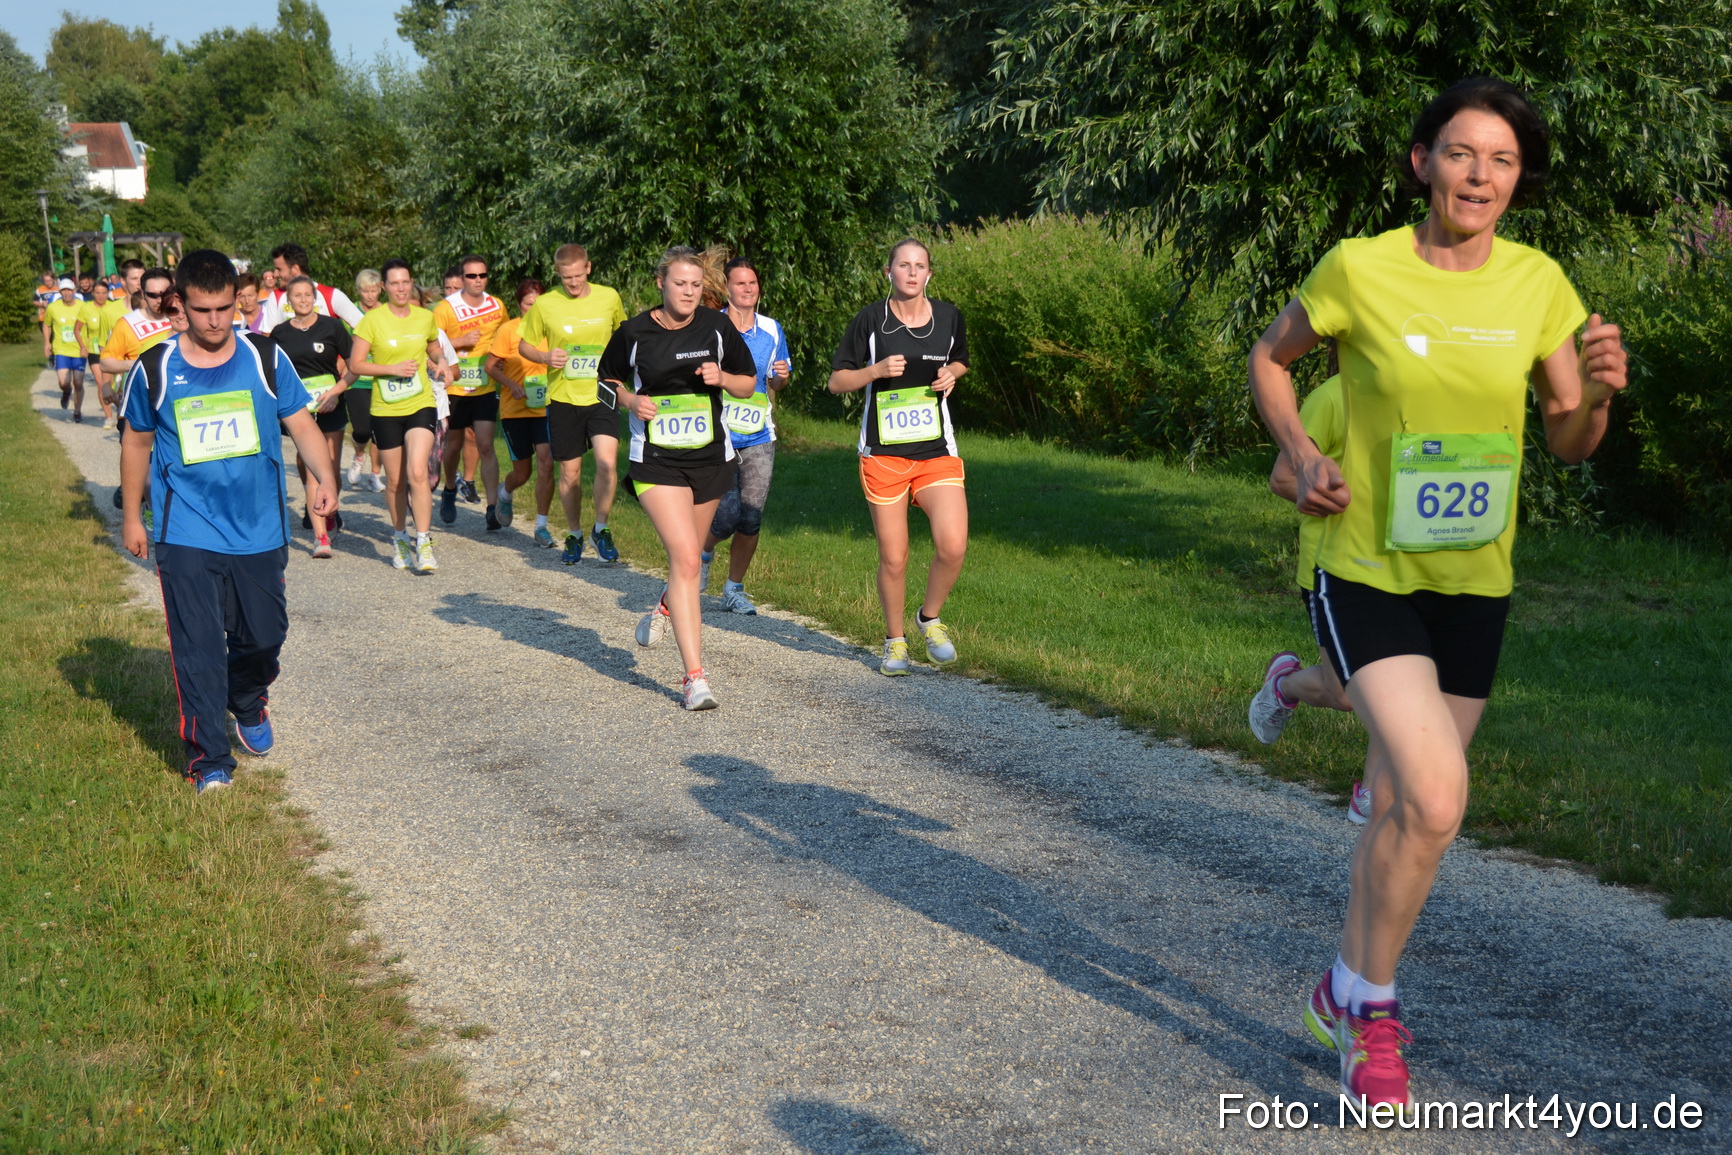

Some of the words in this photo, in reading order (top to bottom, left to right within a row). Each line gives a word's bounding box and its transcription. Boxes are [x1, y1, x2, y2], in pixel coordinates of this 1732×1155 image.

[459, 319, 481, 332] MAX
[482, 312, 502, 326] BÖGL
[571, 357, 597, 370] 674
[681, 350, 710, 359] PFLEIDERER
[460, 368, 483, 379] 882
[387, 375, 414, 393] 673
[724, 403, 761, 425] 1120
[884, 408, 933, 429] 1083
[193, 417, 240, 444] 771
[655, 415, 707, 436] 1076
[1412, 453, 1458, 463] firmenlauf
[1416, 480, 1490, 519] 628
[1427, 527, 1451, 536] Agnes
[1451, 526, 1475, 534] Brandl
